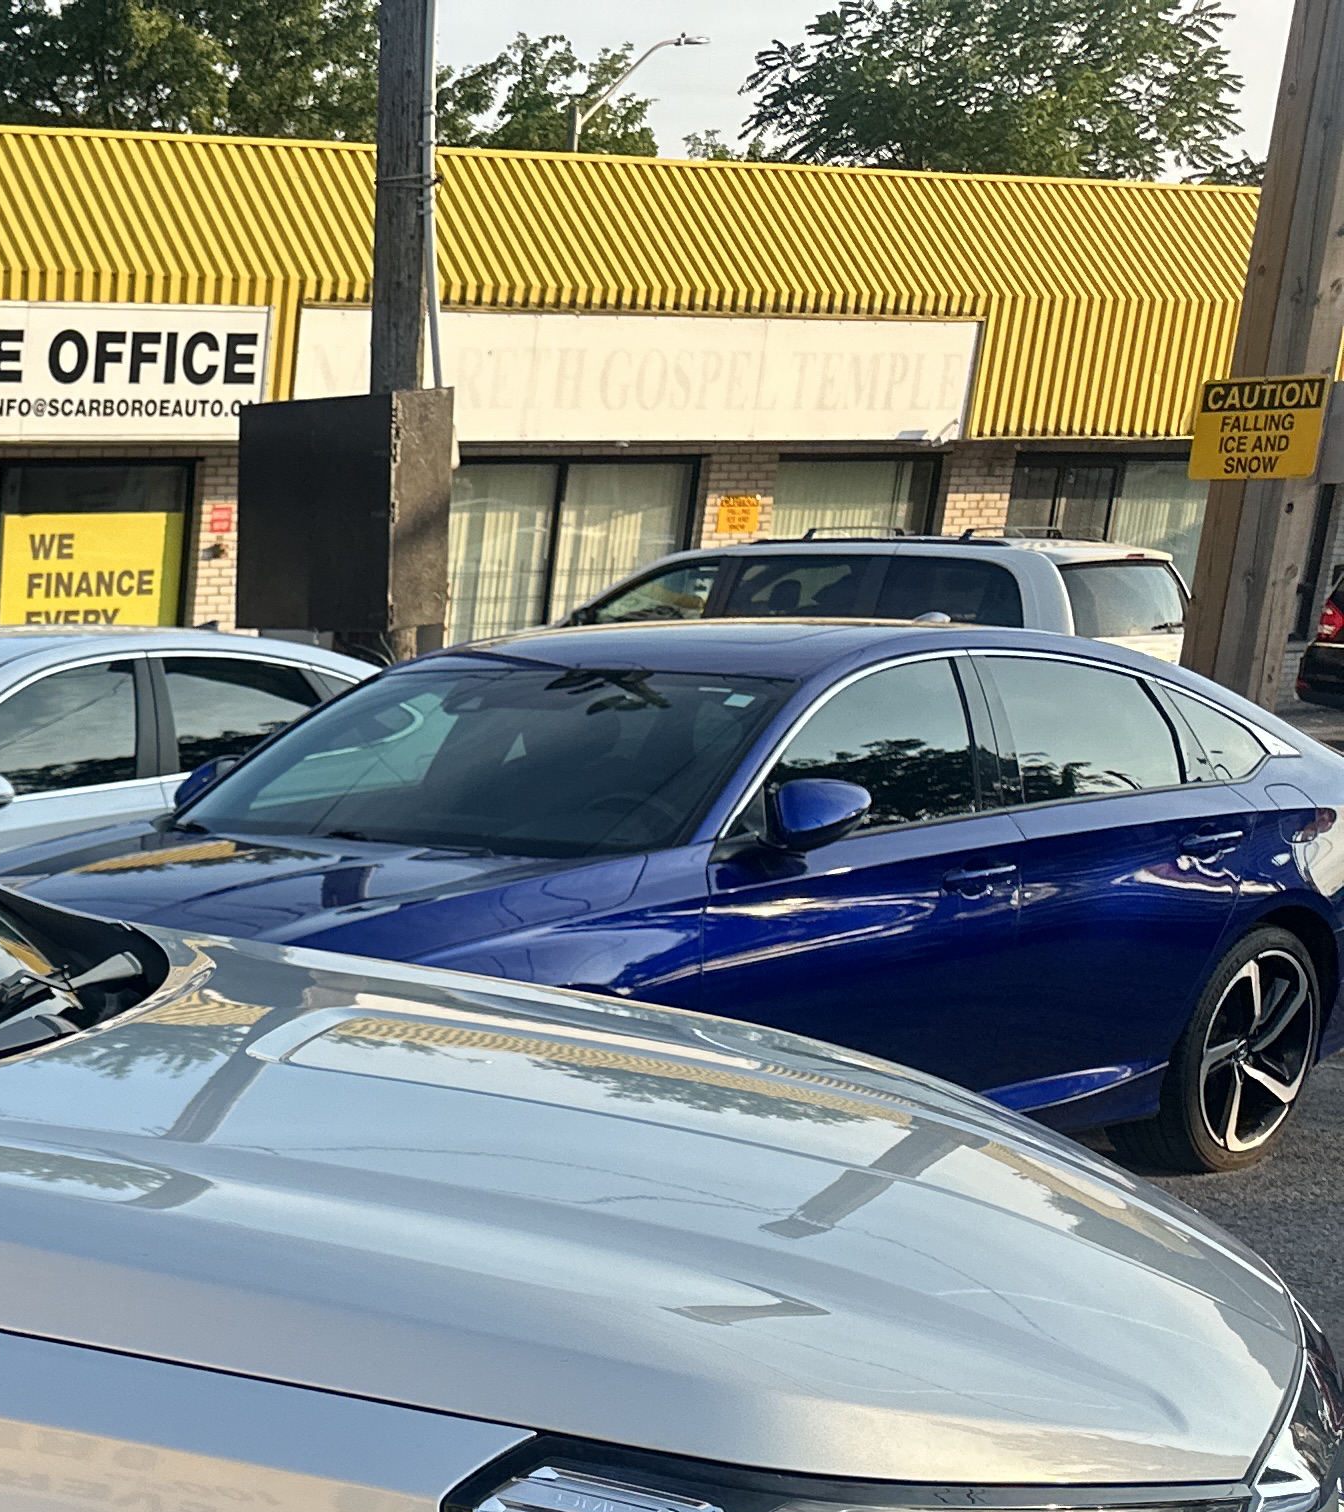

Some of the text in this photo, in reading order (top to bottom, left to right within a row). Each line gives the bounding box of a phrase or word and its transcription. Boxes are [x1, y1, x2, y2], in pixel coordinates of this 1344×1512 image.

[48, 329, 259, 386] OFFICE
[597, 348, 779, 412] GOSPEL
[791, 350, 965, 412] TEMPLE
[1207, 382, 1320, 410] CAUTION
[1219, 413, 1295, 433] FALLING
[1218, 435, 1290, 454] ICE AND
[1223, 455, 1279, 474] SNOW
[29, 533, 75, 560] WE
[26, 569, 155, 599] FINANCE
